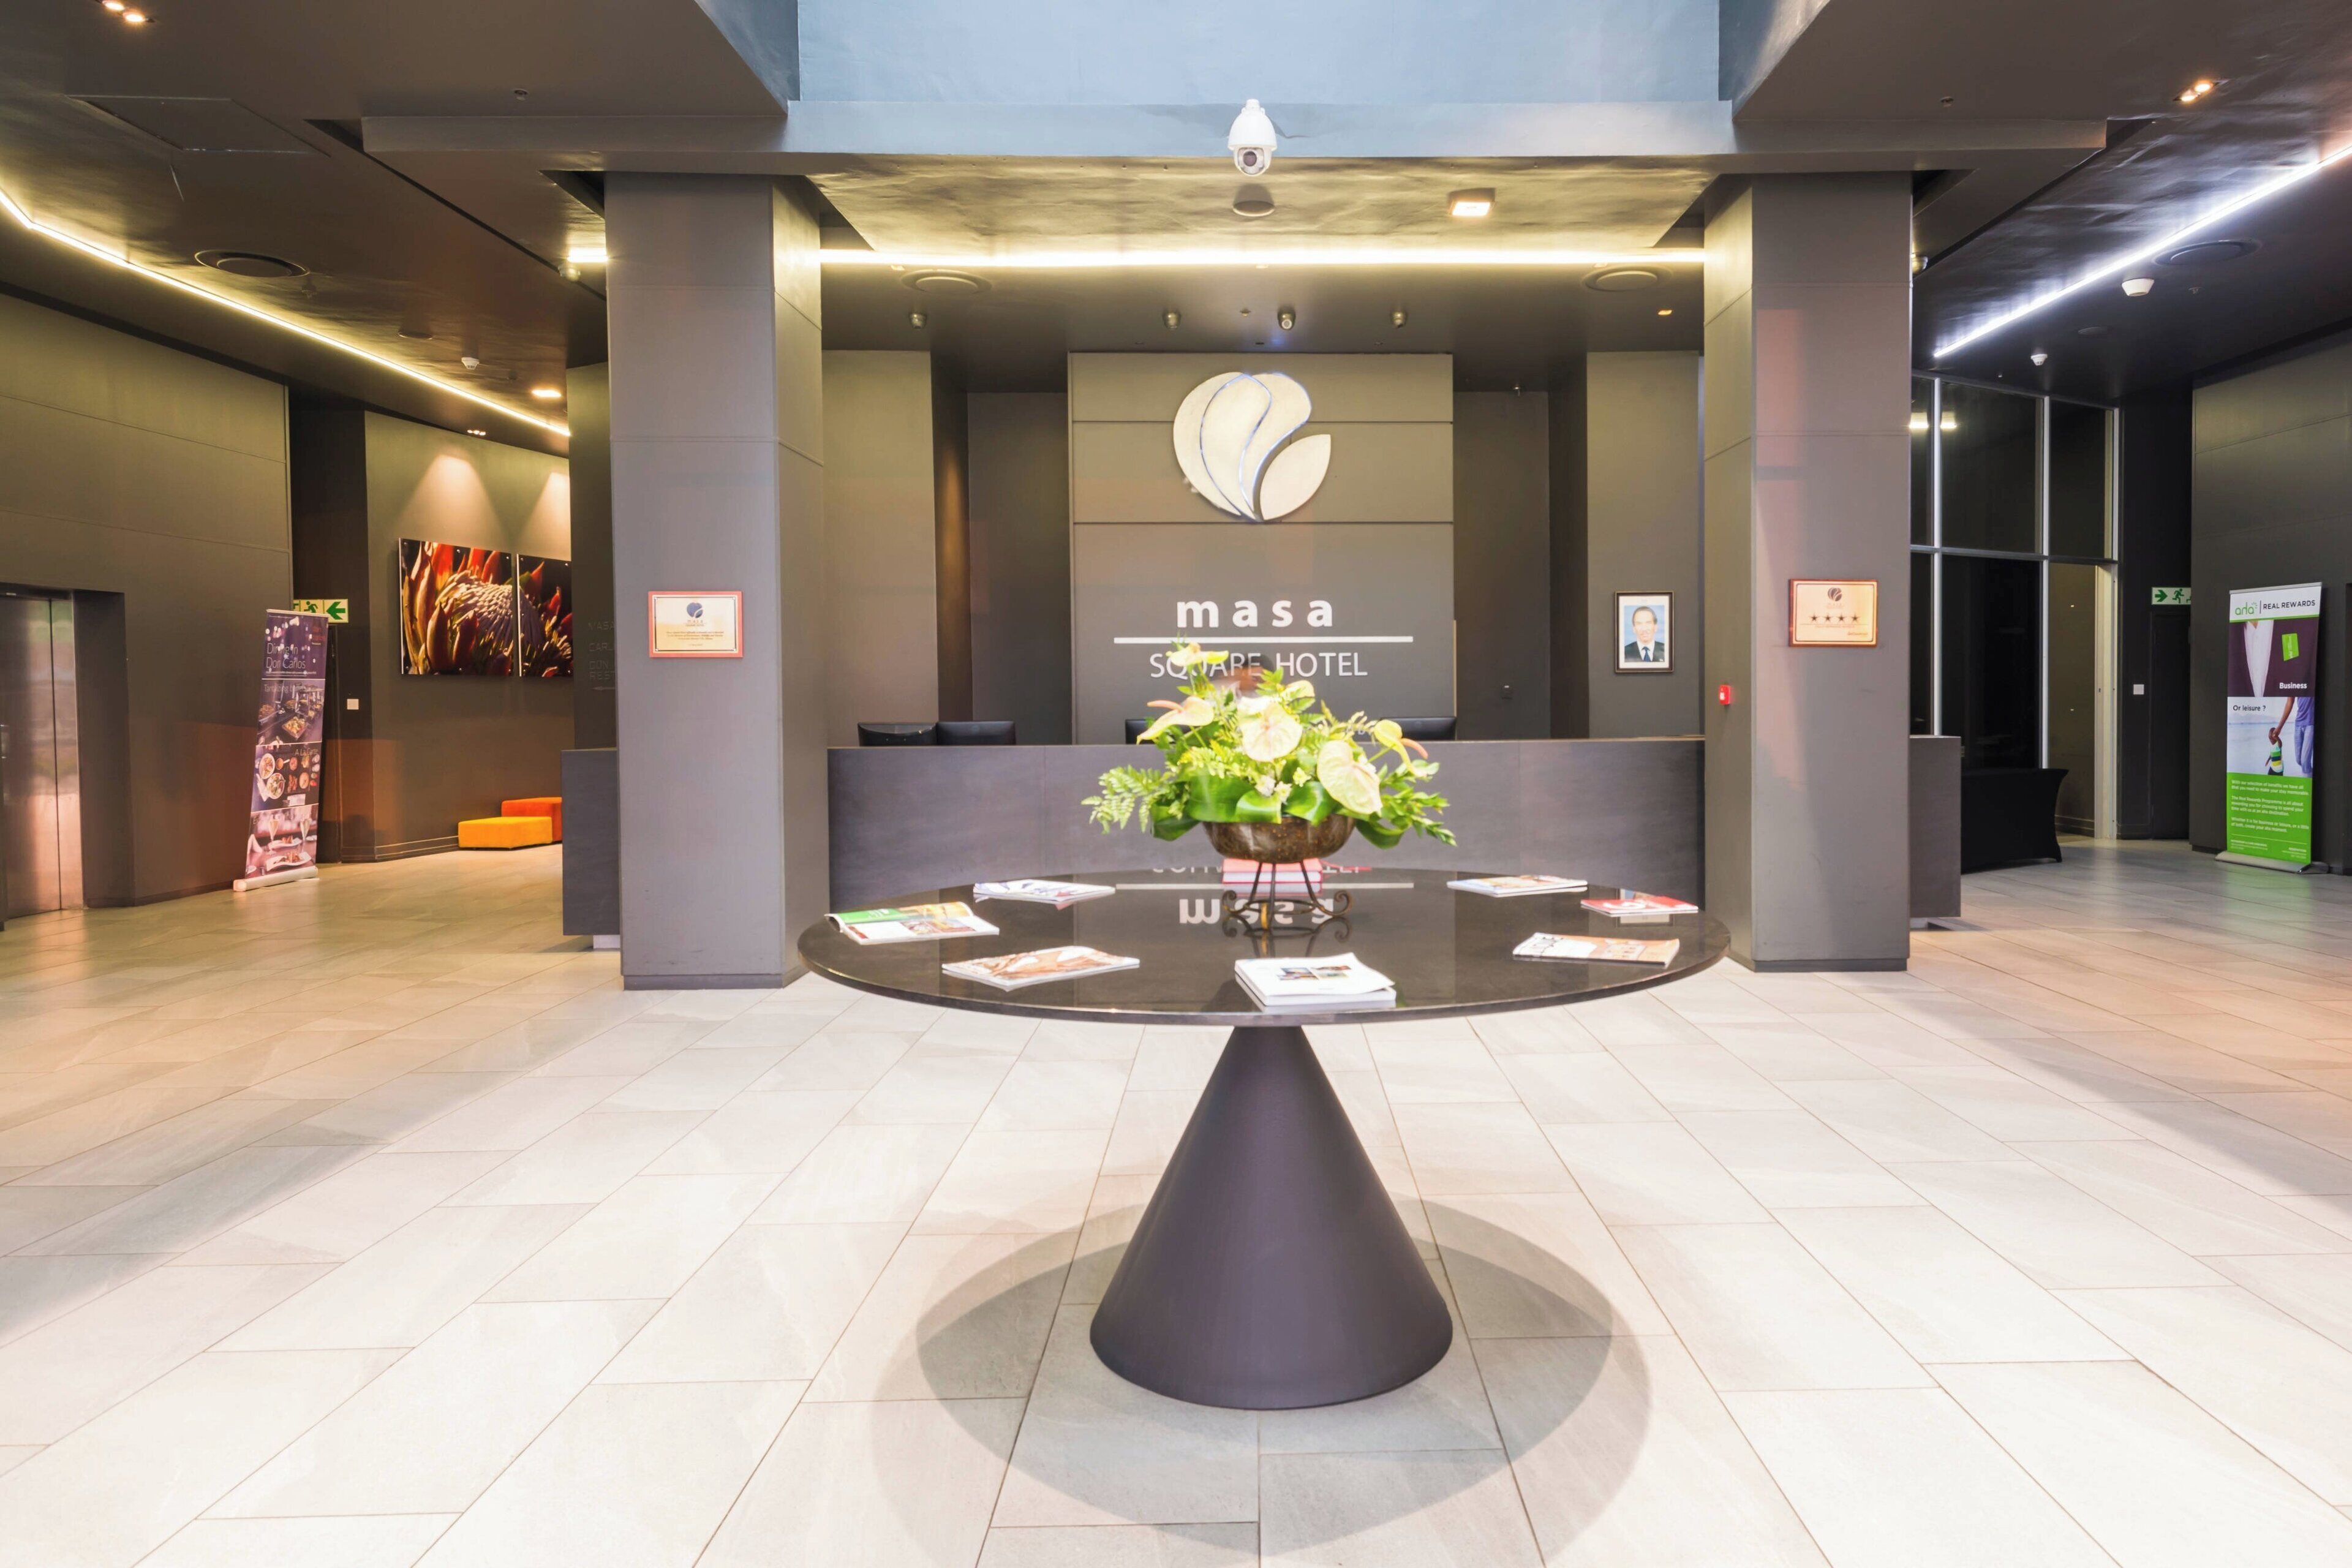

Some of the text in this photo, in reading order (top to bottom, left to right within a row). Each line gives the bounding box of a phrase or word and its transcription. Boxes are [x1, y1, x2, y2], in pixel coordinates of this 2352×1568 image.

[2281, 600, 2315, 608] REWARDS
[1177, 599, 1333, 628] masa
[267, 643, 290, 655] Dinng
[266, 657, 306, 669] Don Carlos
[1276, 652, 1368, 677] HOTEL
